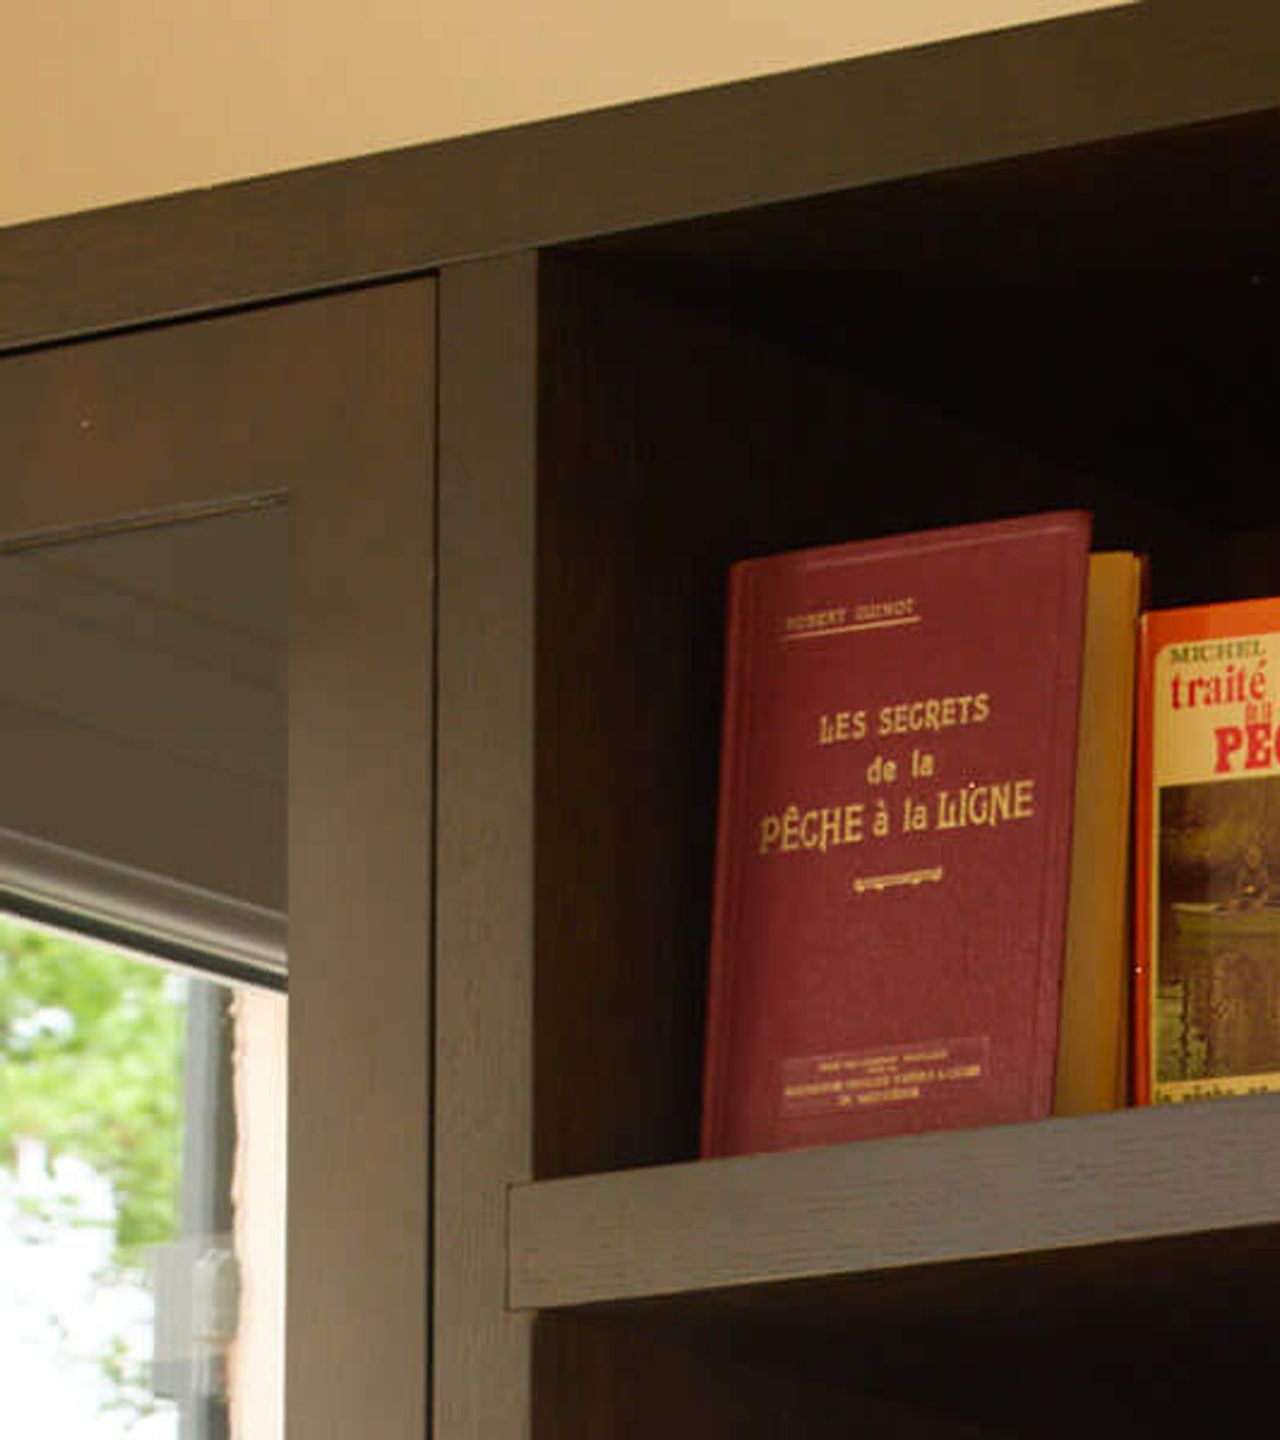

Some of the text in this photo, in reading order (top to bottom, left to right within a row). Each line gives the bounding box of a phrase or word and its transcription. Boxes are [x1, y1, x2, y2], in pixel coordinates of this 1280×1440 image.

[1170, 639, 1266, 664] MICHEL
[1170, 657, 1268, 710] traité
[820, 692, 990, 744] LES SECRETS
[866, 748, 935, 785] de la
[760, 779, 1036, 855] PÊCHE à la LIGNE
